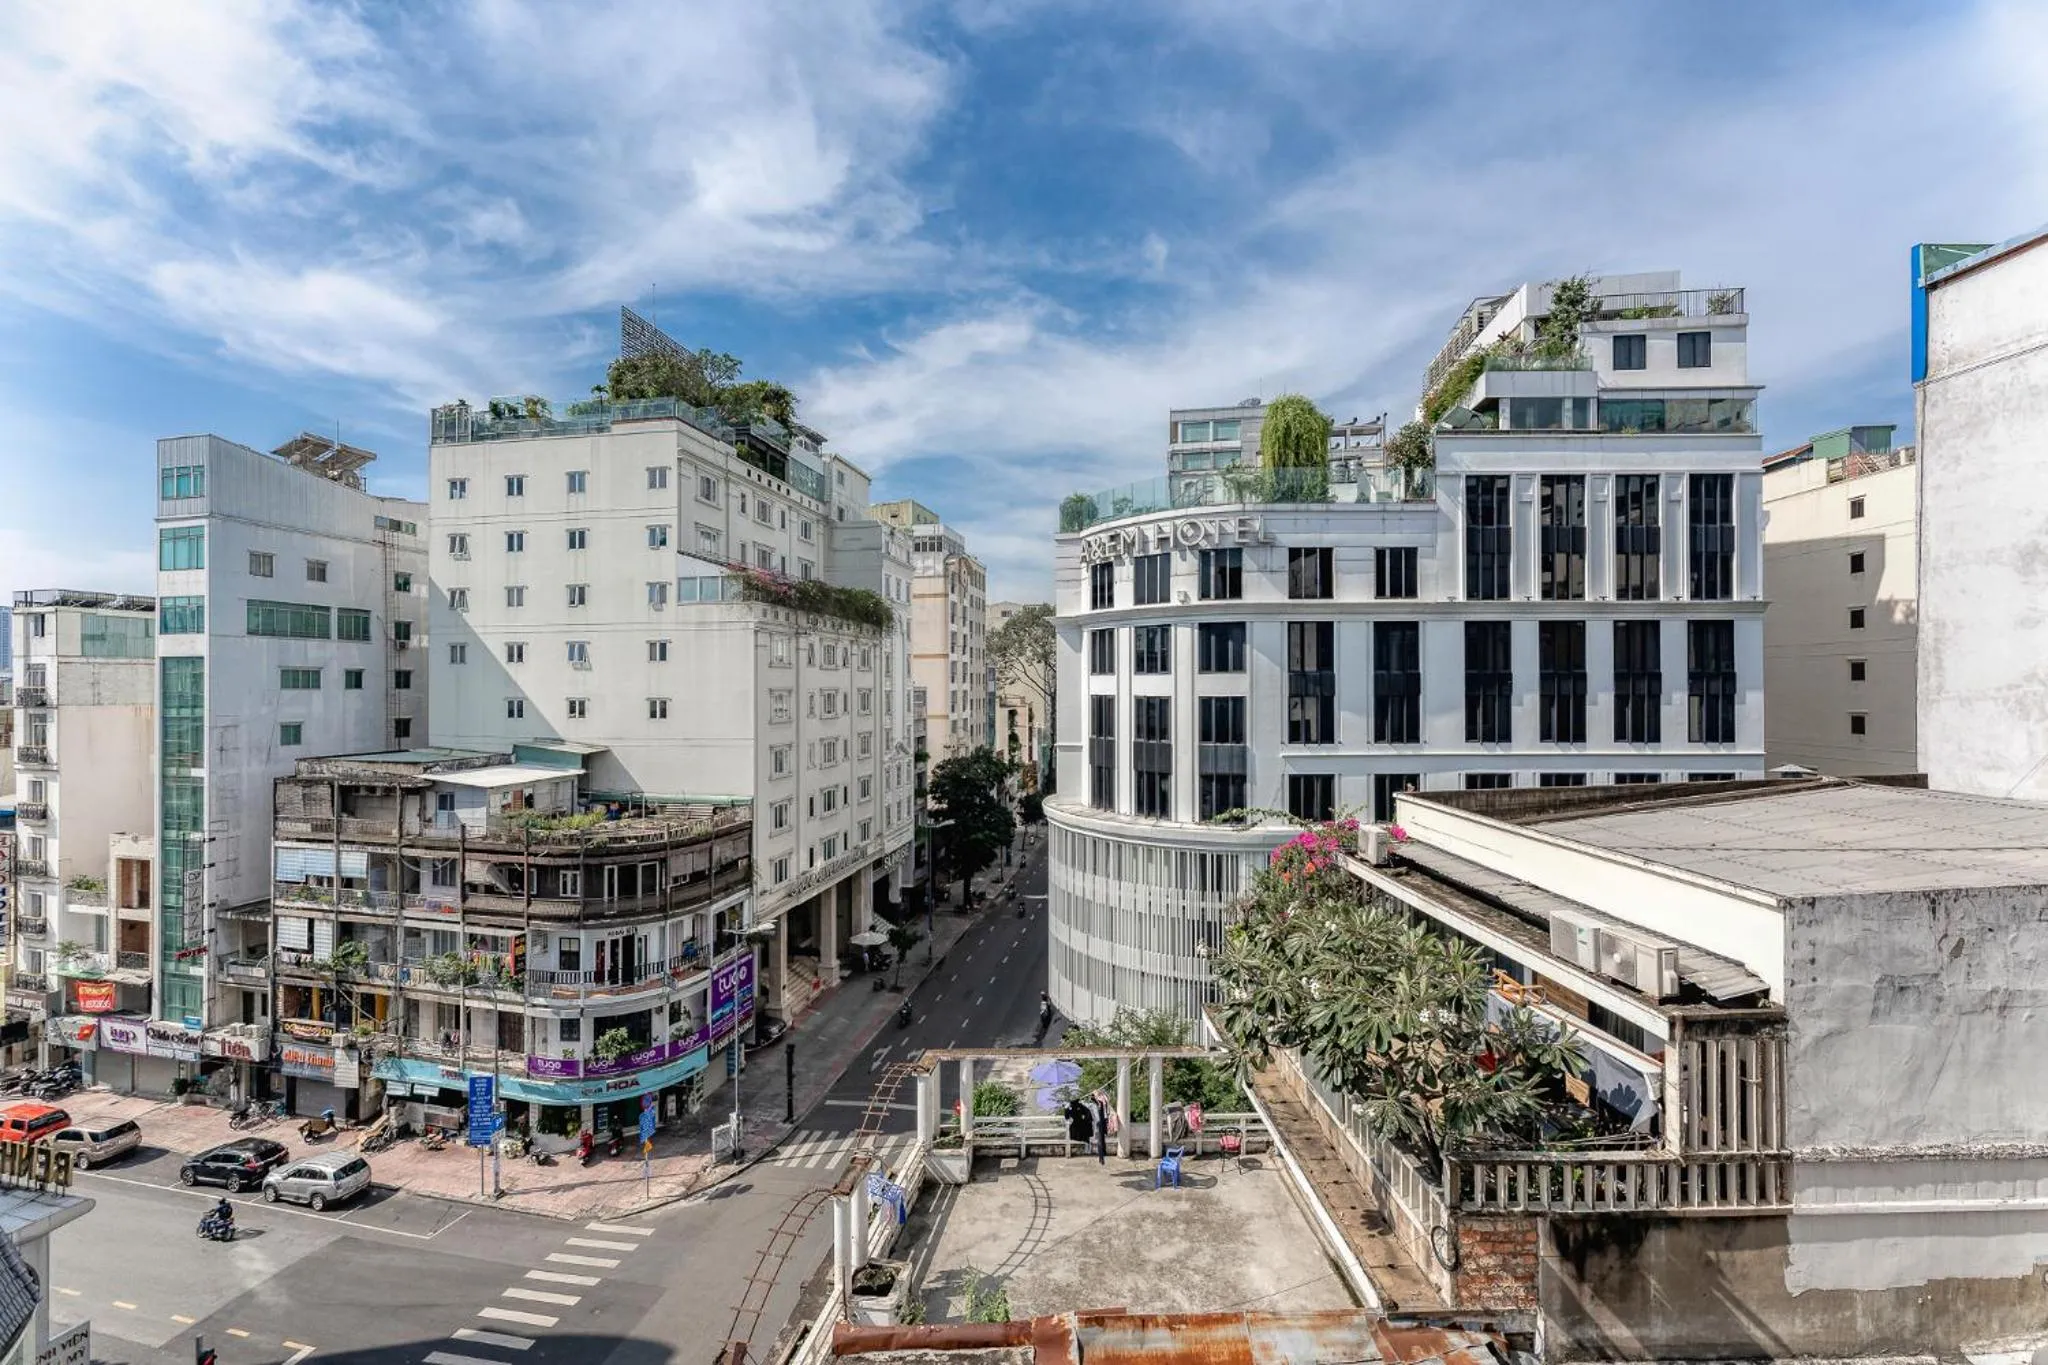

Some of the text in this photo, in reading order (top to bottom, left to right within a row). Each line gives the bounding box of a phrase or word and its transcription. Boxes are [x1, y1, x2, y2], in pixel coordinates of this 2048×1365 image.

[1080, 514, 1271, 563] A&EM HOTEL
[631, 1049, 656, 1064] tugo
[537, 1058, 562, 1071] tugo
